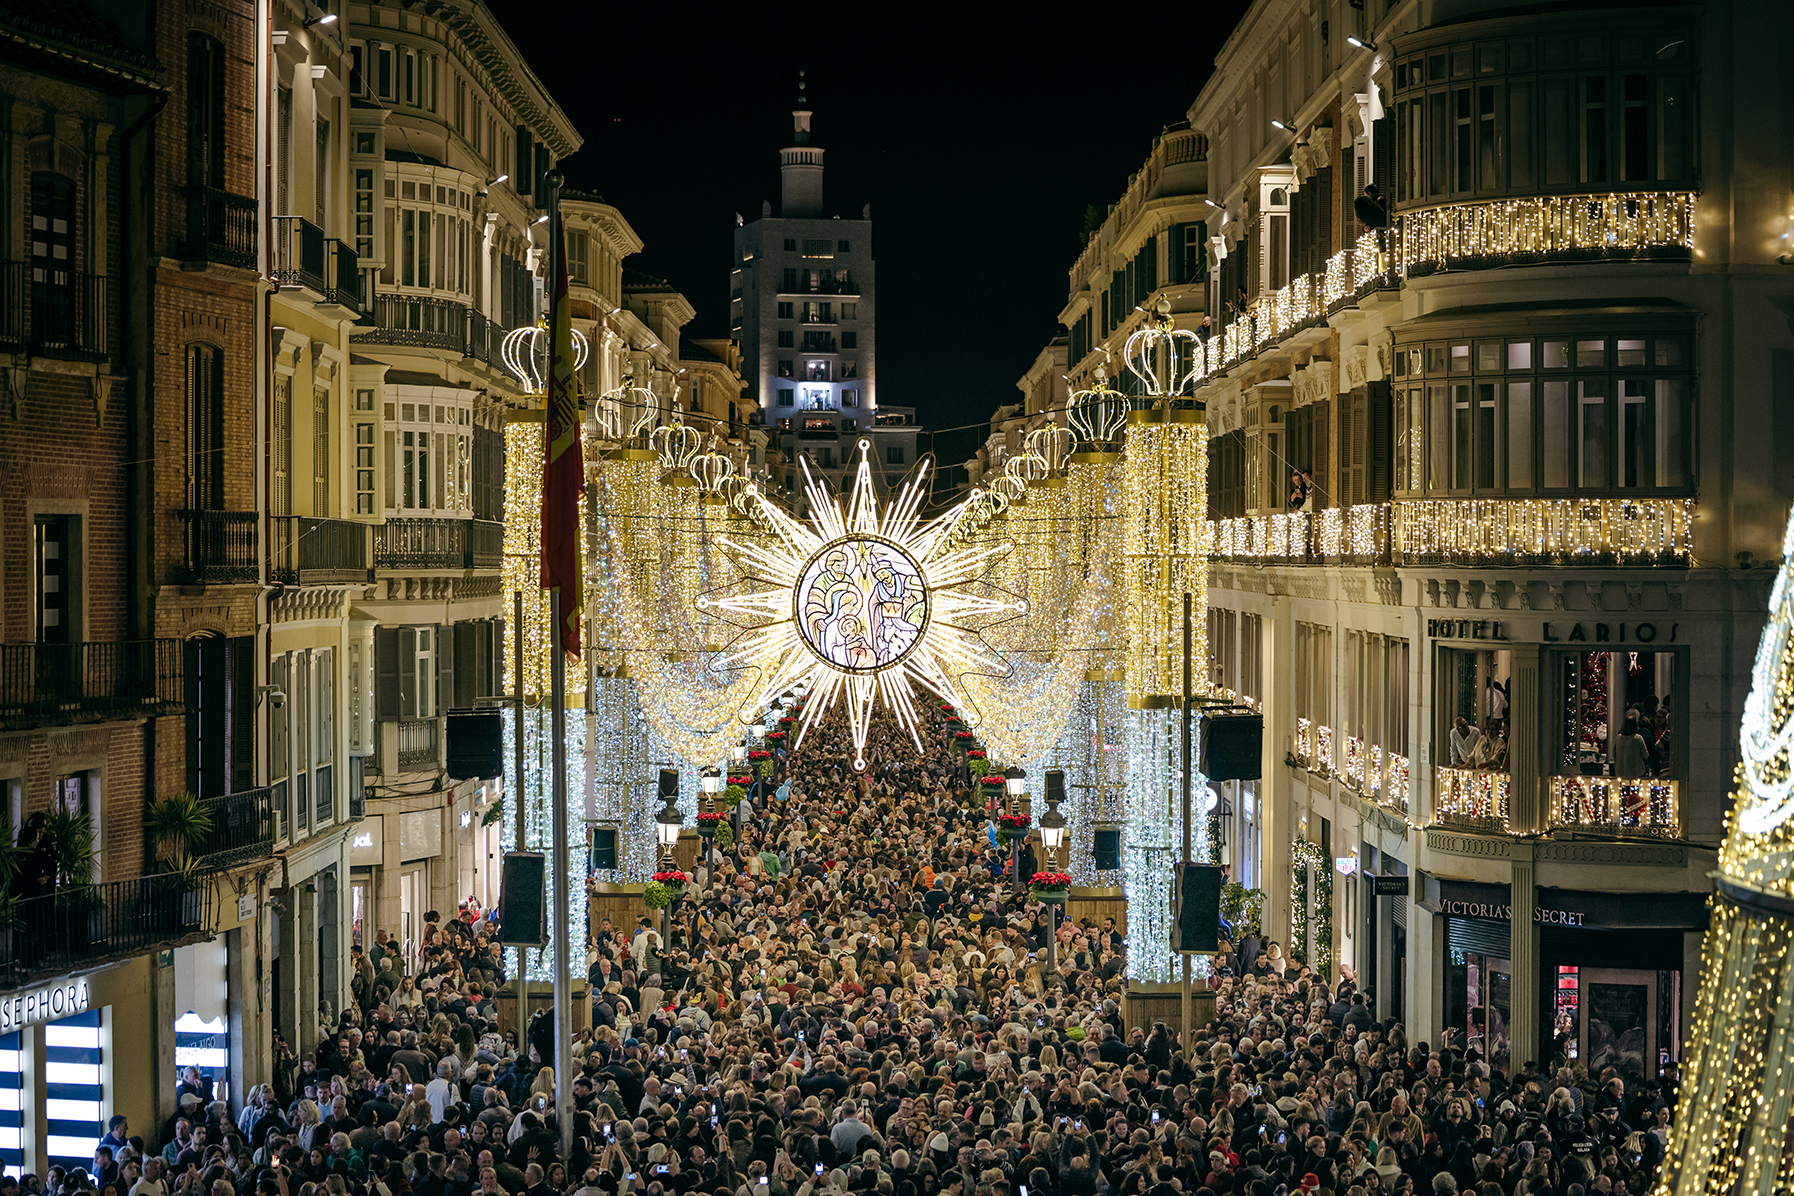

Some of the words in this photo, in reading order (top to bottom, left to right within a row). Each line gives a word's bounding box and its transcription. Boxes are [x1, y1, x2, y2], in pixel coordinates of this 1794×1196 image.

[1428, 618, 1507, 640] HOTEL
[1542, 622, 1680, 643] LARIOS
[1438, 898, 1511, 919] VICTORIA'S
[1533, 906, 1585, 926] SECRET
[1, 981, 89, 1028] SEPHORA
